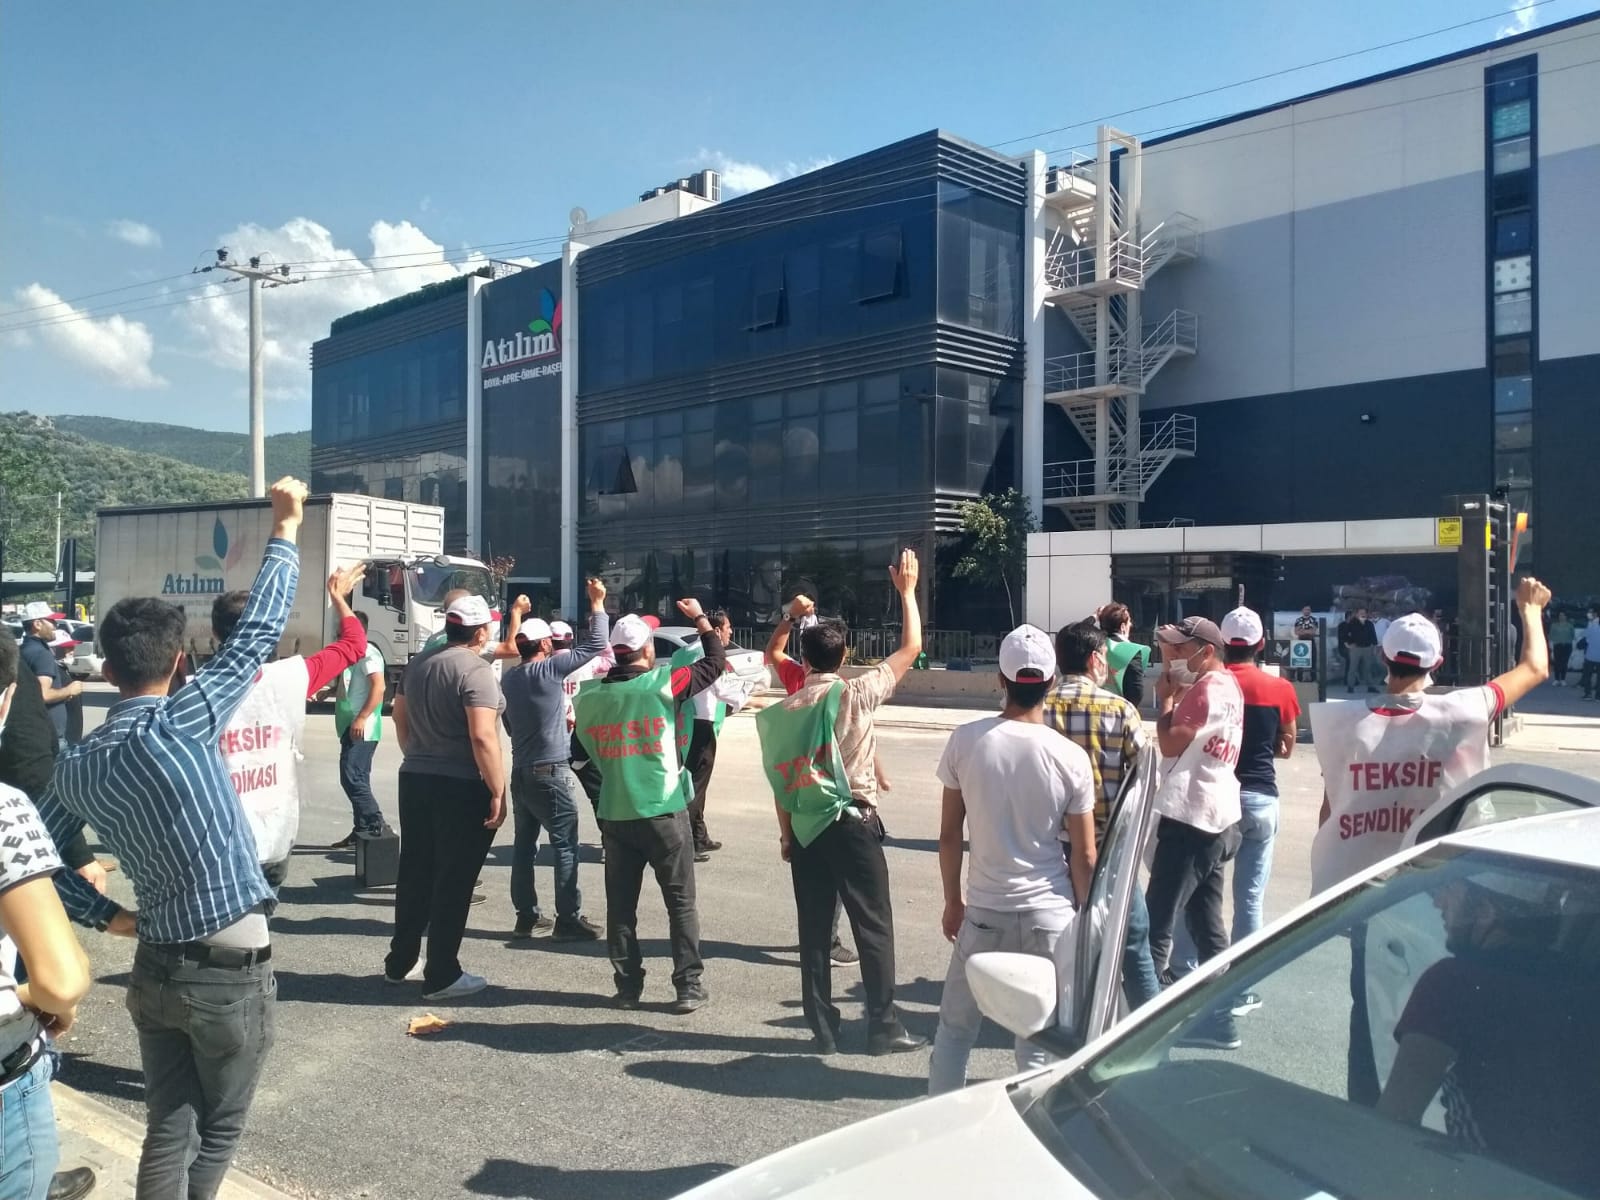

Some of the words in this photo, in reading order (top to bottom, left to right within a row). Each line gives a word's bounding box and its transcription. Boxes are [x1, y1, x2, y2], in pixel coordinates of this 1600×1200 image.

[481, 331, 556, 369] Atılım
[161, 573, 225, 594] Atılım
[230, 762, 277, 795] DİKASI
[1349, 754, 1442, 791] TEKSİF
[1339, 801, 1418, 841] SENDİK
